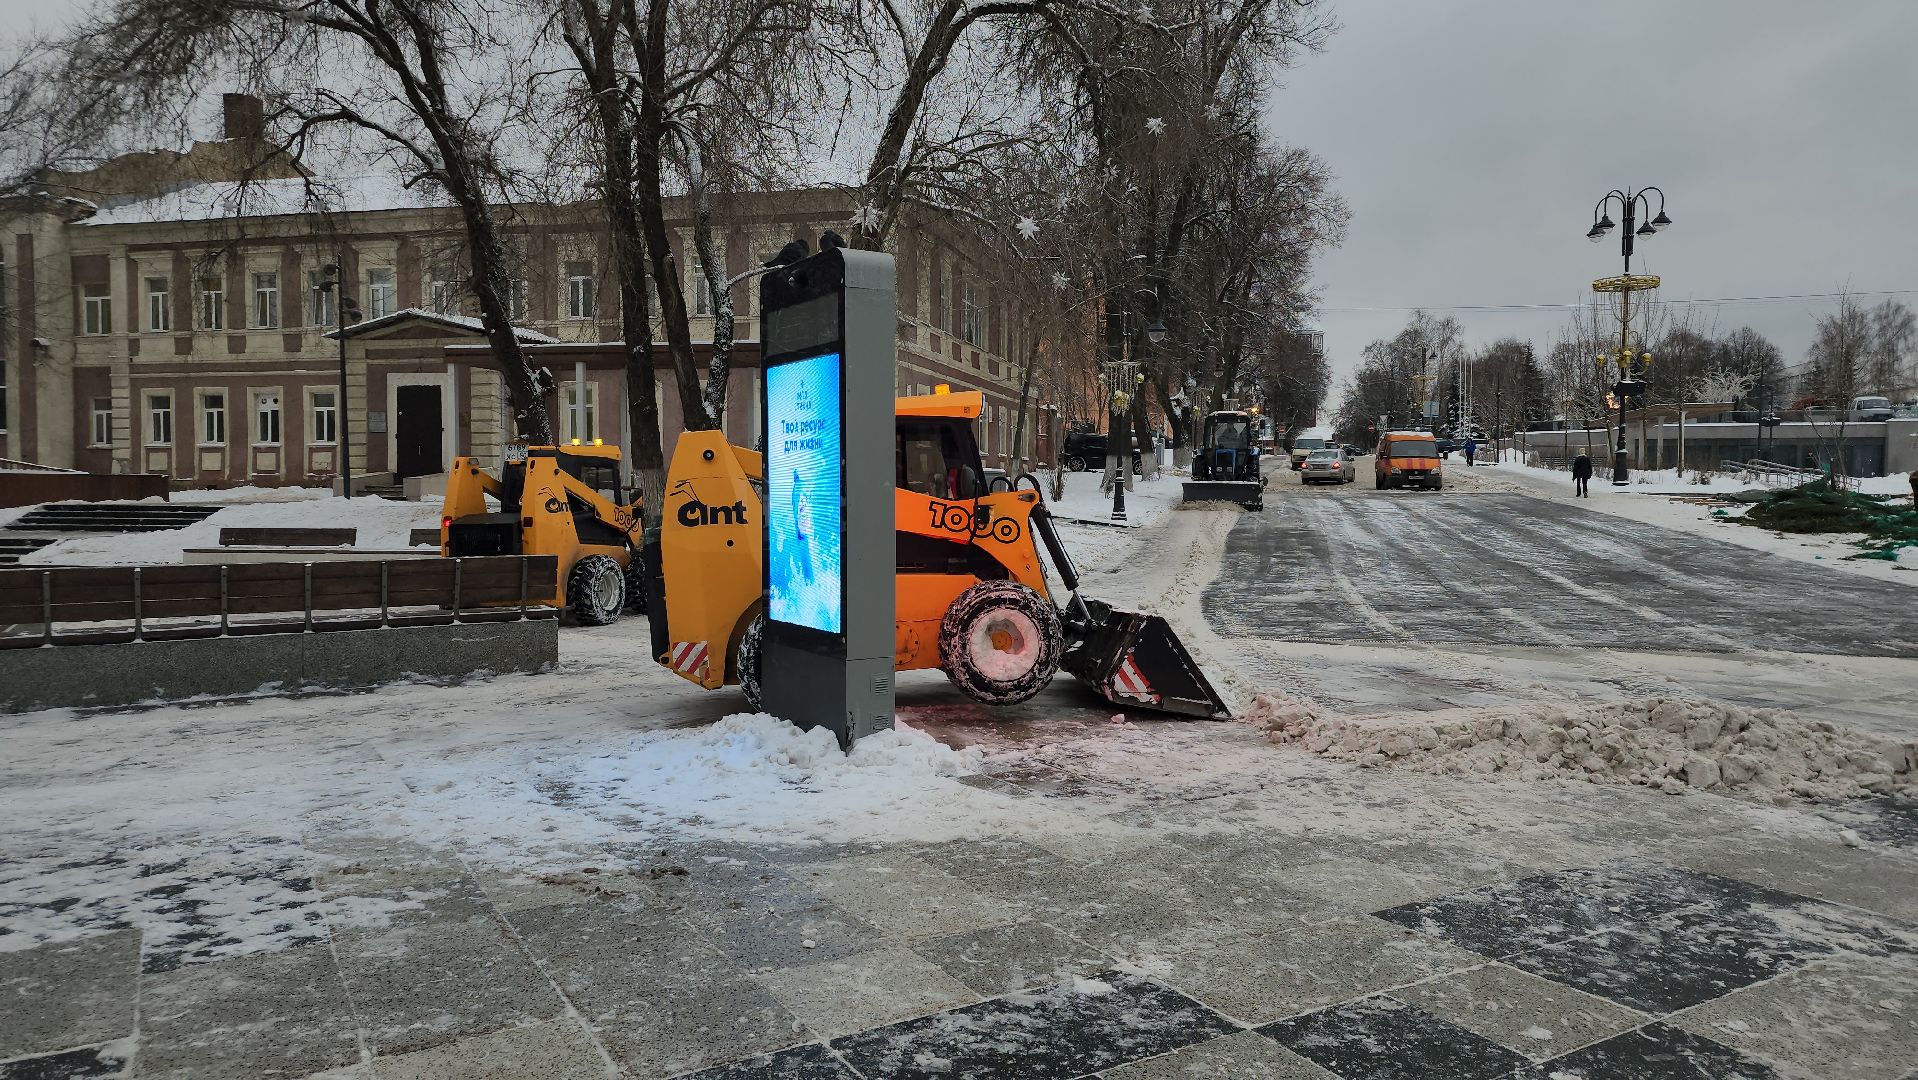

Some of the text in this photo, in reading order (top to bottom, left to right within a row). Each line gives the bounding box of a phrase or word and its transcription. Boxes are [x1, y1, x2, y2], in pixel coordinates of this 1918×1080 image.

[781, 418, 825, 436] Твой ресурс
[784, 437, 823, 454] для жизни
[677, 500, 748, 527] ant
[928, 500, 1021, 544] 1000
